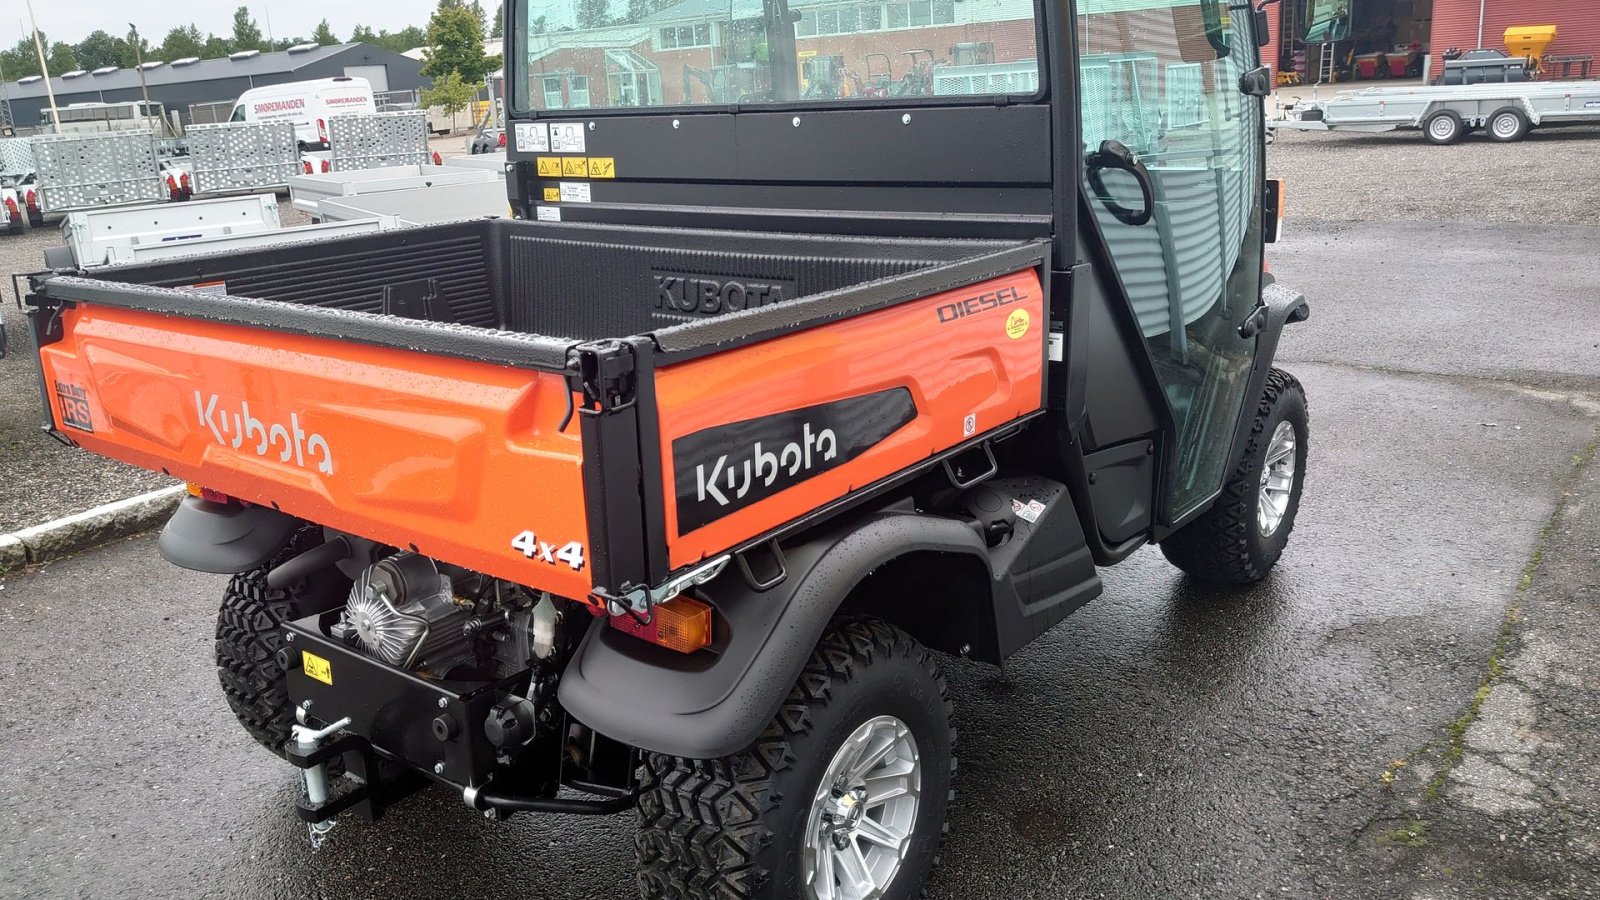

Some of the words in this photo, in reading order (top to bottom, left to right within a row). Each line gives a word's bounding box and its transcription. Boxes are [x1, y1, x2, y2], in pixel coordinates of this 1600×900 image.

[254, 98, 305, 114] SMØREMANDEN
[936, 286, 1028, 324] DIESEL
[58, 396, 91, 424] IRS
[194, 390, 334, 475] Kubota
[696, 422, 837, 506] Kubota
[511, 529, 586, 572] 4x4
